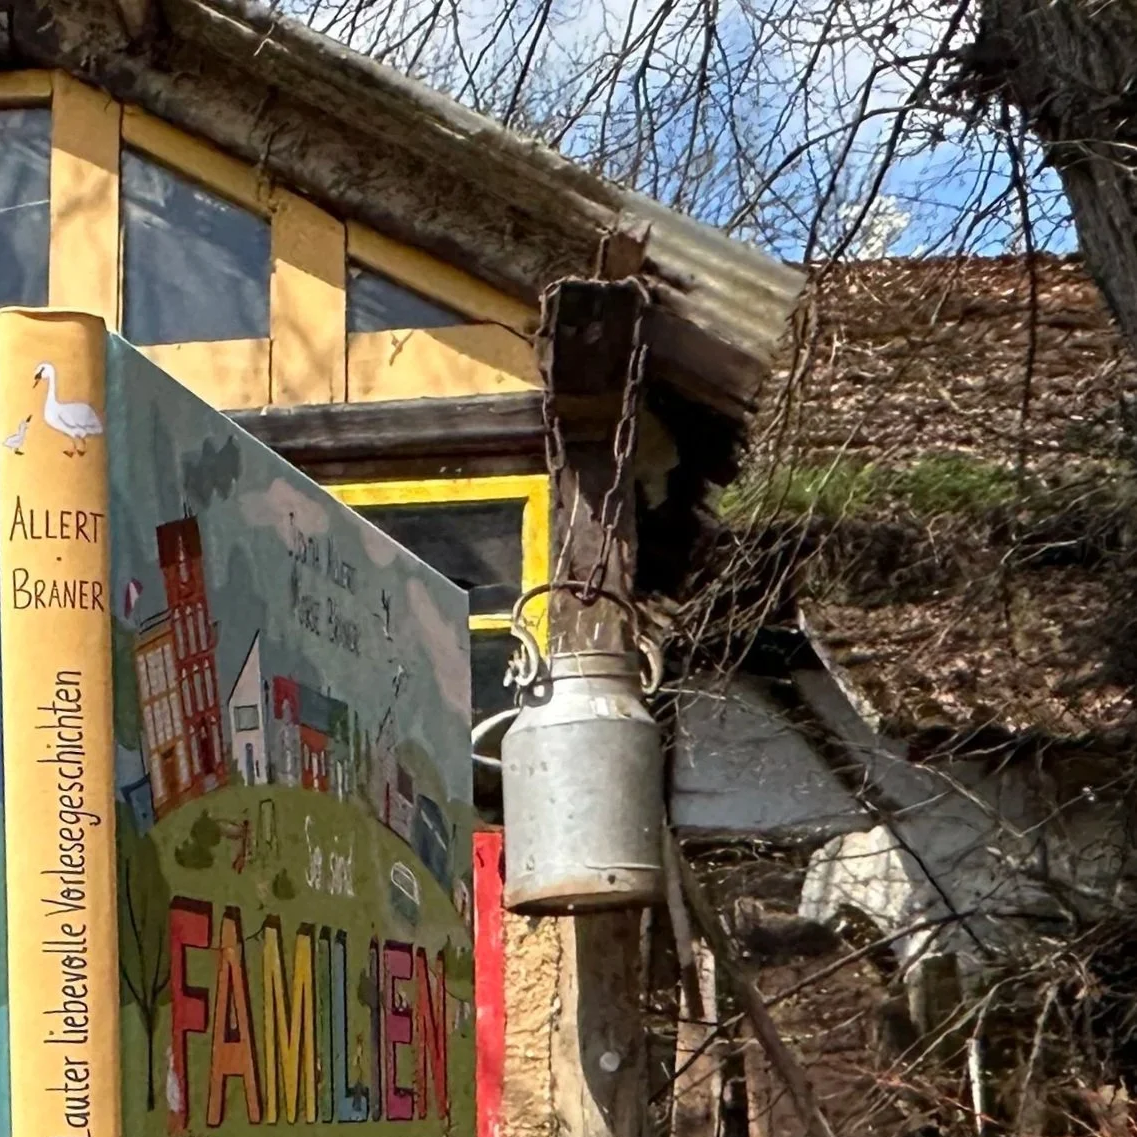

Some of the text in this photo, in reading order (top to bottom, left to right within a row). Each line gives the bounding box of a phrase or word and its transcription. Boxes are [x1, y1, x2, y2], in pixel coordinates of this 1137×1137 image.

[9, 495, 105, 543] ALLERT
[12, 568, 105, 613] BRANER
[34, 670, 102, 917] Vorlesegeschichten
[41, 922, 89, 1044] liebevolle
[167, 895, 451, 1130] FAMILIEN
